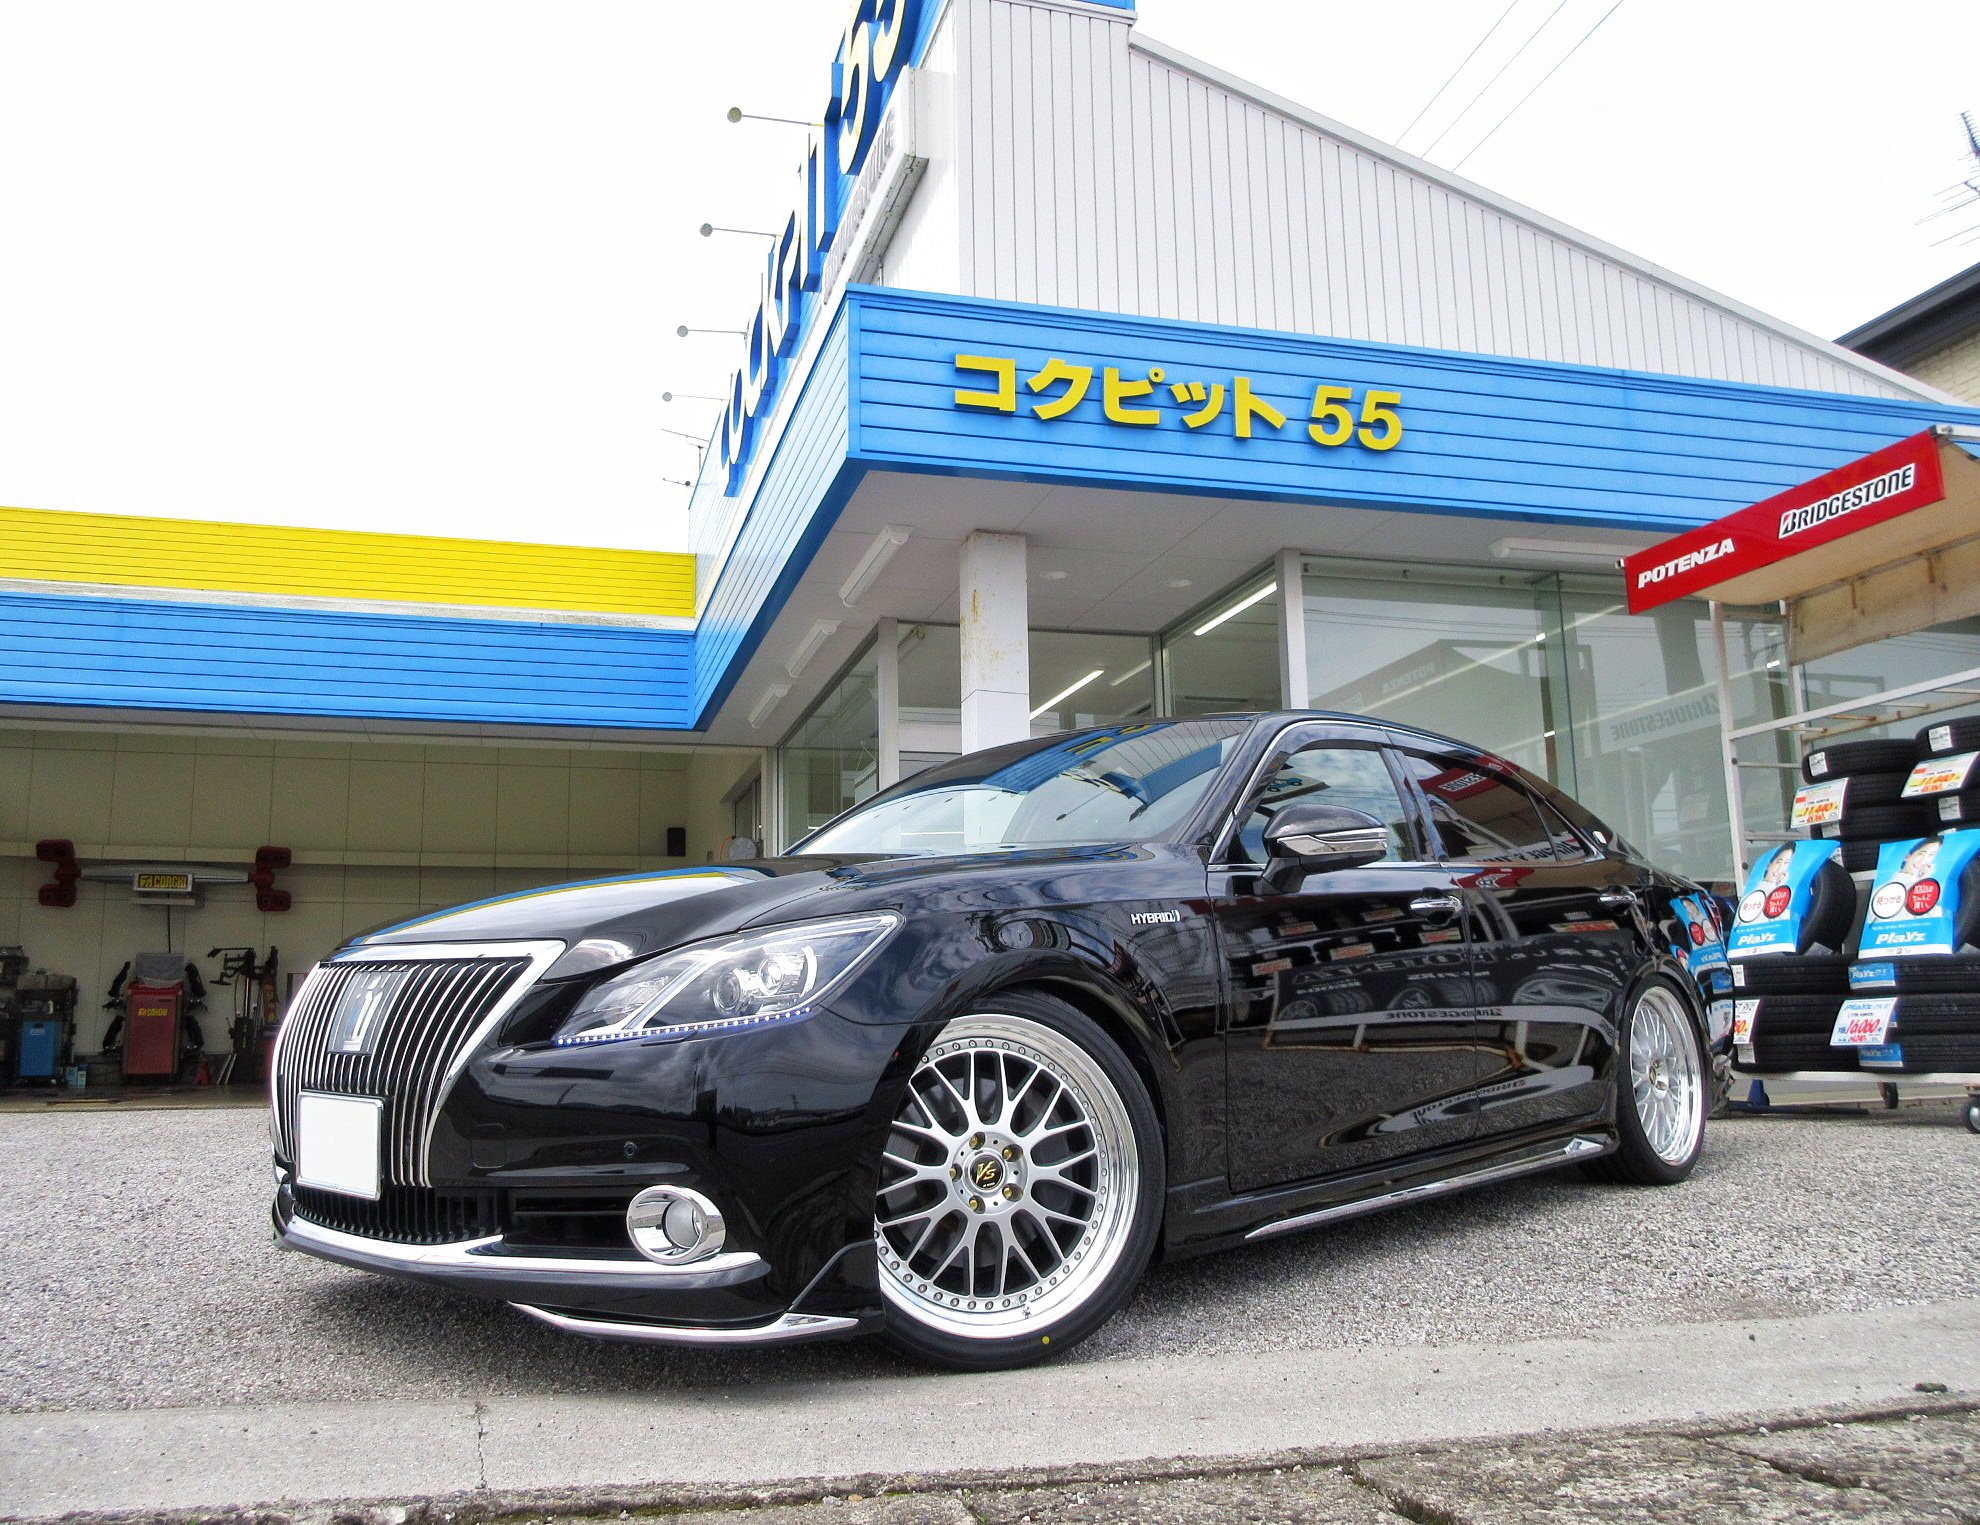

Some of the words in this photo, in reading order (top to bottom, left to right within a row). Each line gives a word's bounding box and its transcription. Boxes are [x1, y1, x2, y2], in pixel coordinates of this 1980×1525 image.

[954, 354, 1286, 439] コクピット
[1308, 384, 1402, 451] 55
[1780, 464, 1914, 536] BRIDGESTONE
[1638, 538, 1735, 589] POTENZA
[153, 875, 187, 888] CORGHI
[1130, 911, 1175, 924] HYBRID
[1738, 933, 1776, 946] Playz
[1875, 931, 1926, 945] Playz
